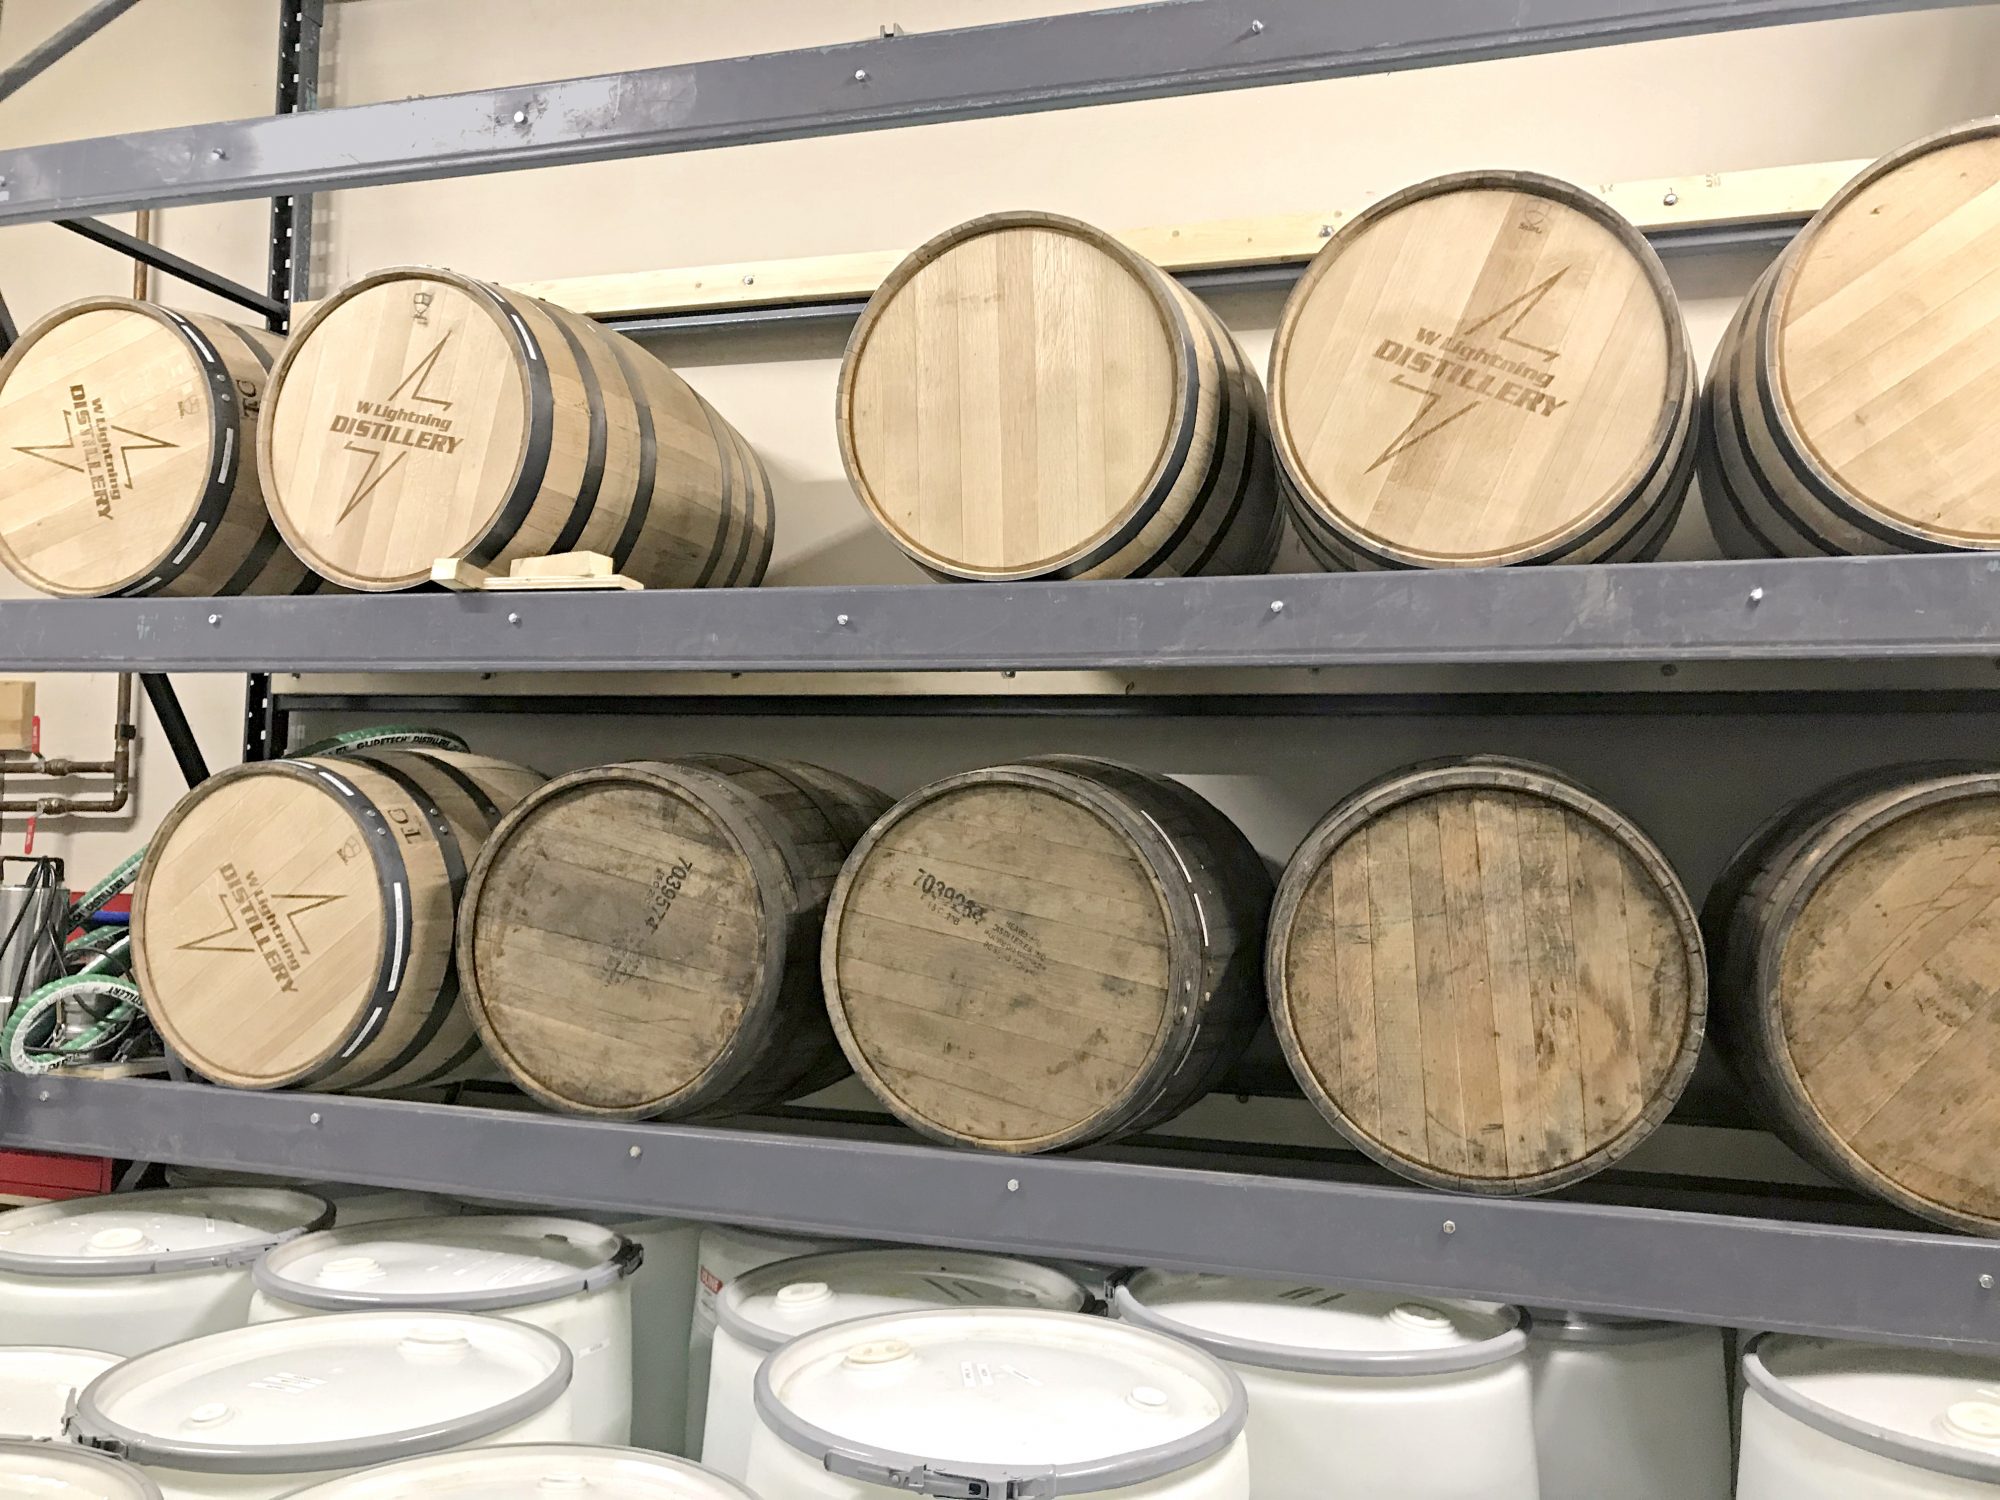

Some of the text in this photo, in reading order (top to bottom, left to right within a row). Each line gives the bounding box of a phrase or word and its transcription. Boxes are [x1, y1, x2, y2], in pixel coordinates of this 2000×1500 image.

[1372, 339, 1568, 417] DISTILLERY
[1415, 327, 1555, 388] W Lightning
[70, 384, 114, 520] DISTILLERY
[92, 397, 121, 501] W Lightning
[329, 415, 464, 454] DISTILLERY
[355, 400, 453, 432] W Lightning
[220, 862, 298, 992] DISTILLERY
[246, 870, 300, 971] W Lightning
